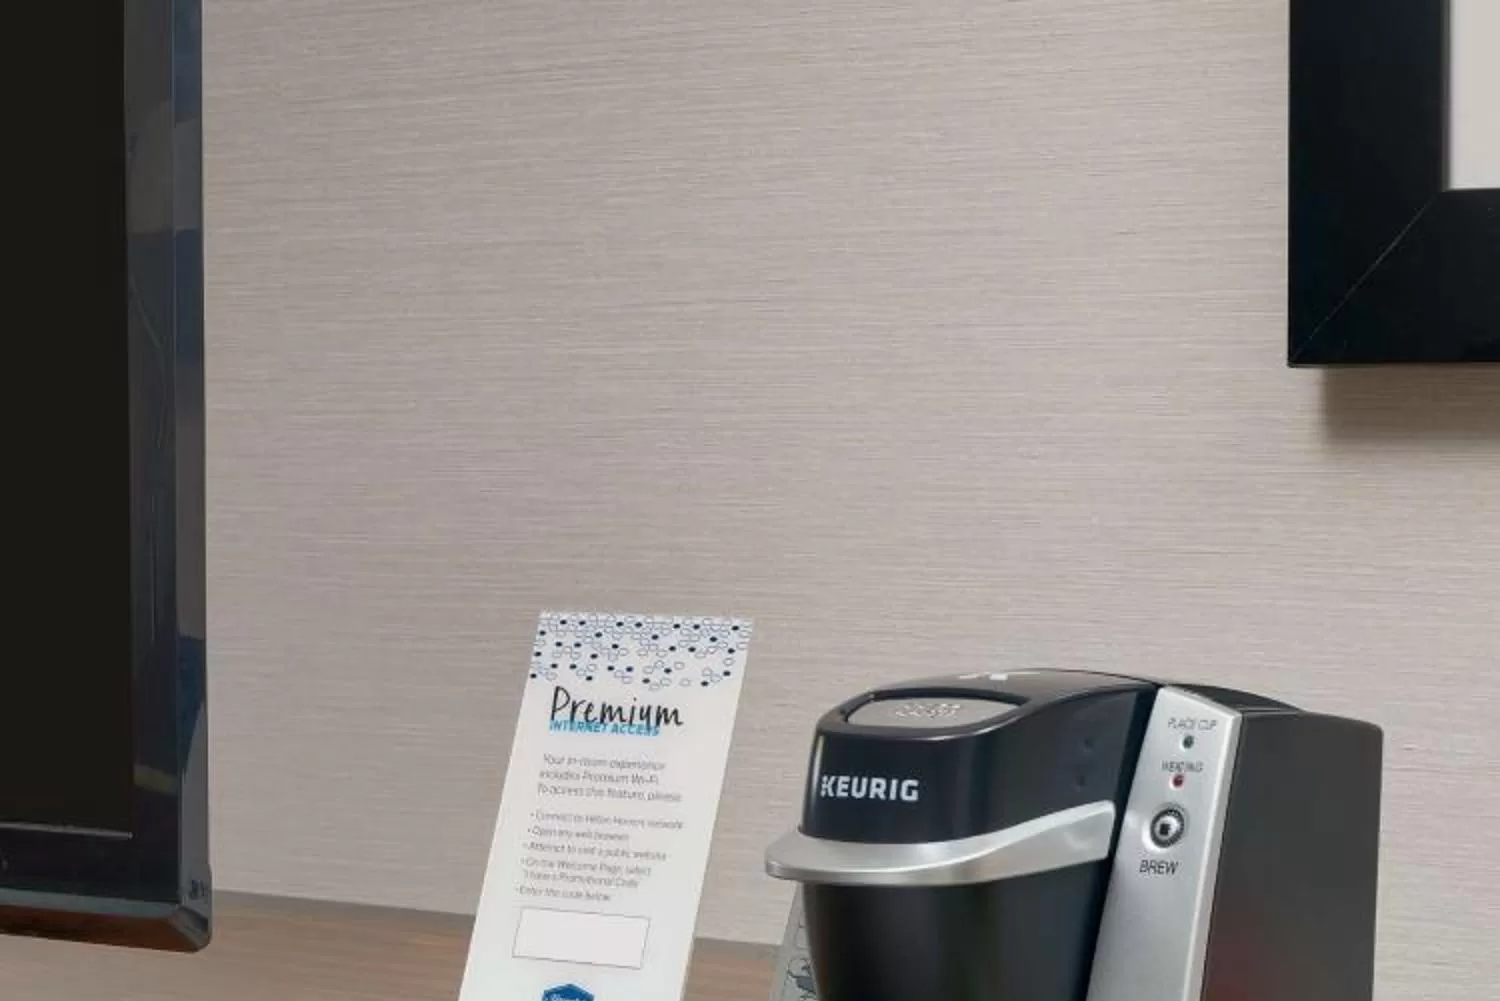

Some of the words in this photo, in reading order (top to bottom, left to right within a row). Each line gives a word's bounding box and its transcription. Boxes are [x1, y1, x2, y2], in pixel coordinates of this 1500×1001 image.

[550, 686, 683, 729] Premium
[821, 774, 919, 801] KEURIG
[1139, 860, 1179, 875] BREW
